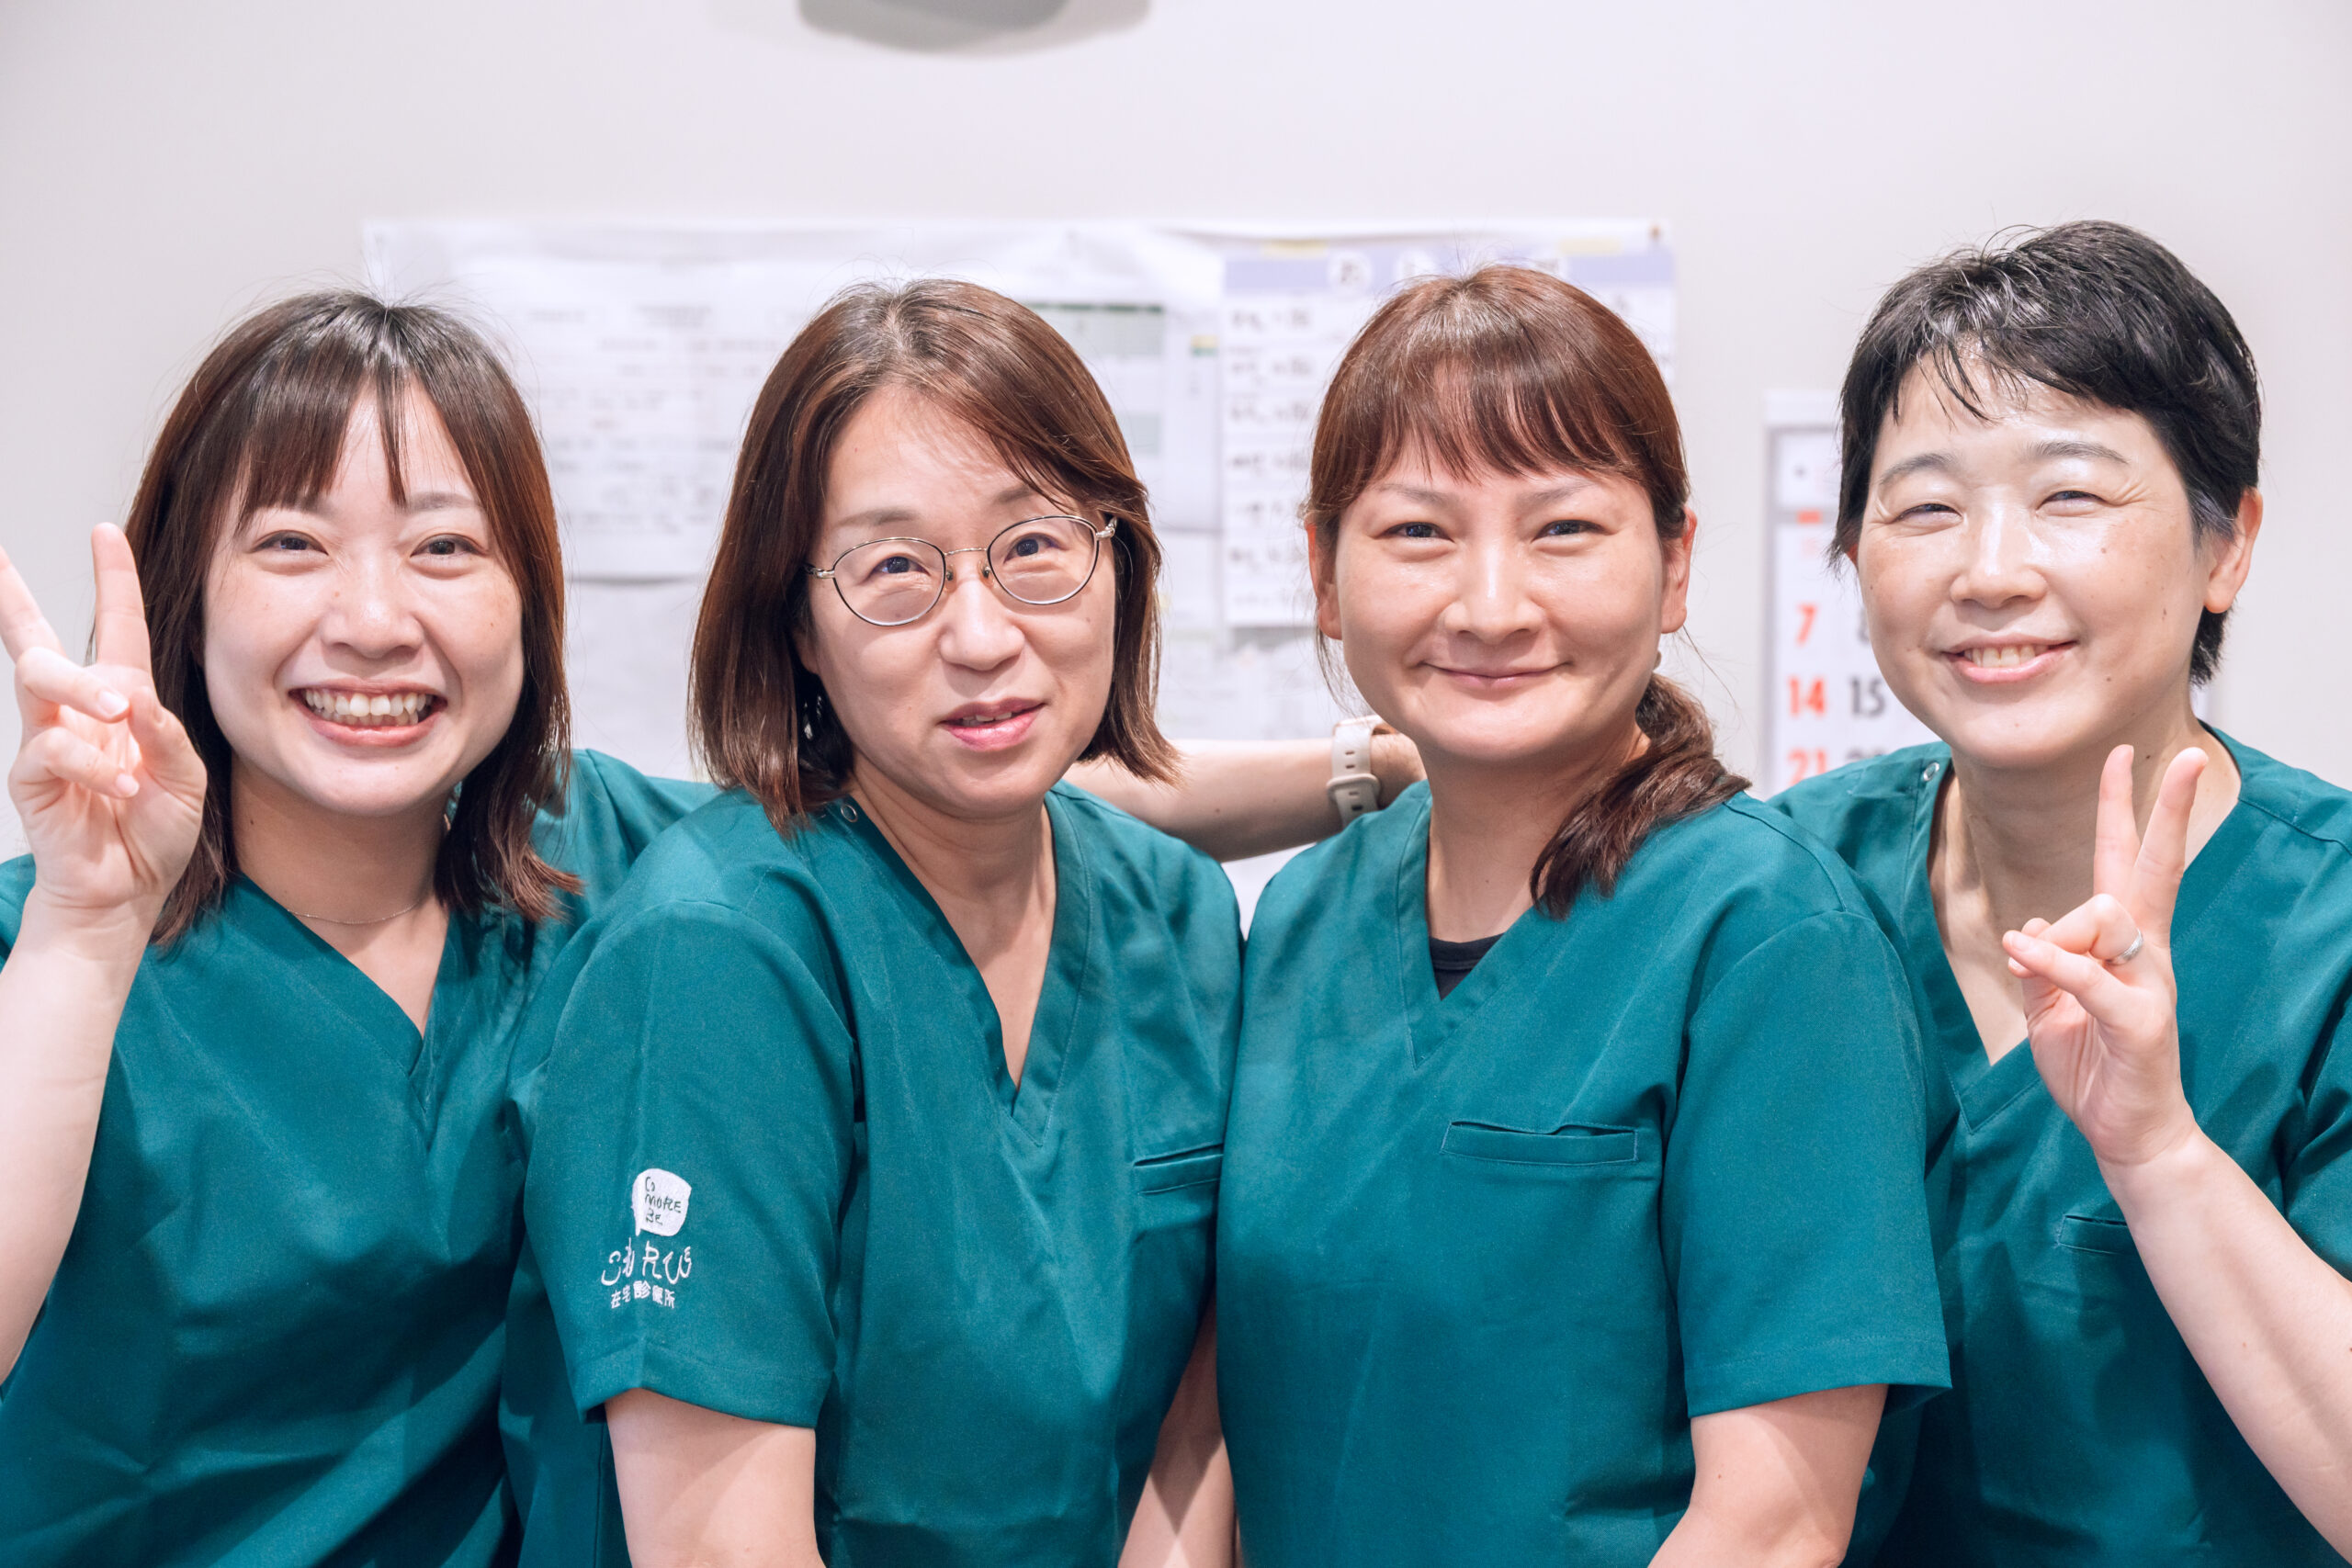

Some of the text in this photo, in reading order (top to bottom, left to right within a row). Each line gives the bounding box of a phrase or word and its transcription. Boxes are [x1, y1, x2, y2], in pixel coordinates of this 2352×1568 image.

[1795, 604, 1818, 646] 7
[1788, 677, 1886, 717] 14 15
